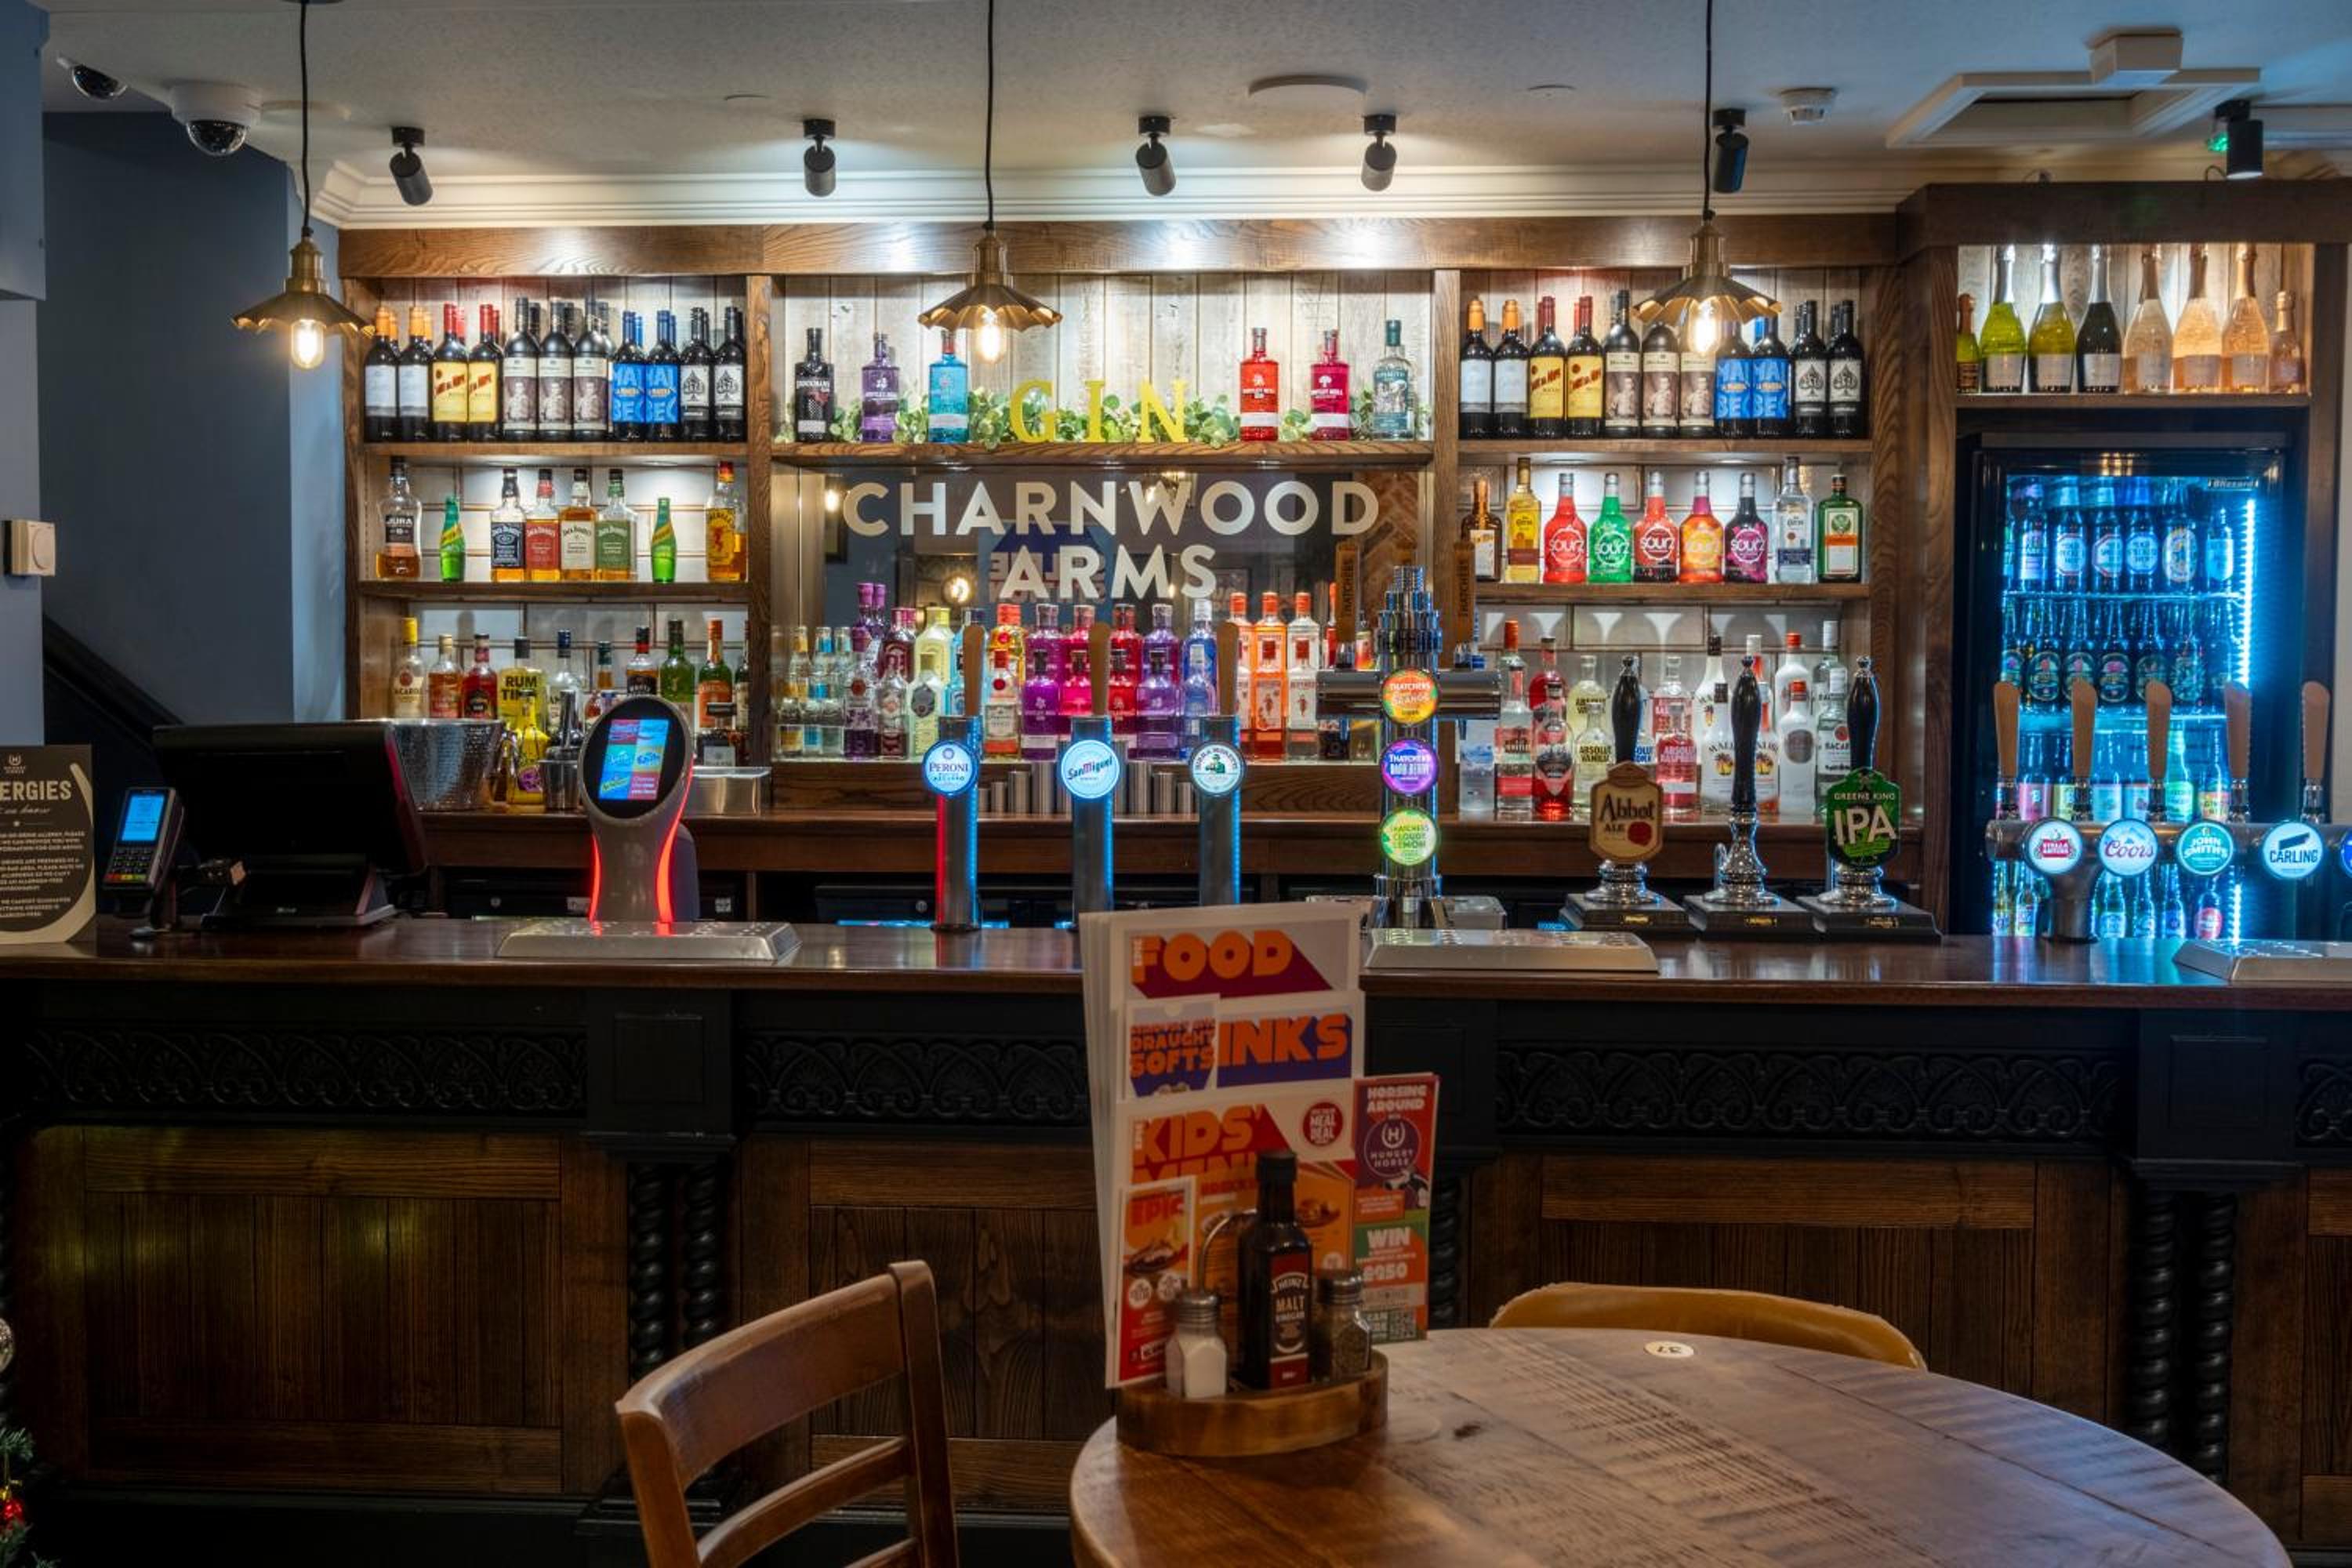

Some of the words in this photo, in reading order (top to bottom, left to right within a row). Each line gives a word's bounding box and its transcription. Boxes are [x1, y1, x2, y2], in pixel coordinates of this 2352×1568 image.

[1010, 379, 1189, 444] GIN
[843, 481, 1380, 536] CHARNWOOD
[999, 544, 1217, 599] ARMS
[506, 676, 538, 687] RUM
[929, 764, 968, 772] PERONI
[0, 780, 72, 801] ERGIES
[1599, 793, 1655, 821] Abbot
[1834, 804, 1896, 846] IPA
[2105, 840, 2154, 858] Coors
[2270, 849, 2318, 864] CARLING
[1131, 930, 1294, 982] FOOD
[1131, 1031, 1214, 1052] DRAUGHT
[1218, 1014, 1348, 1066] INKS
[1130, 1048, 1214, 1079] SOFTS
[1367, 1085, 1427, 1099] HORSING
[1367, 1098, 1425, 1113] AROUND
[1367, 1226, 1410, 1249] WIN
[1276, 1295, 1305, 1313] MALT
